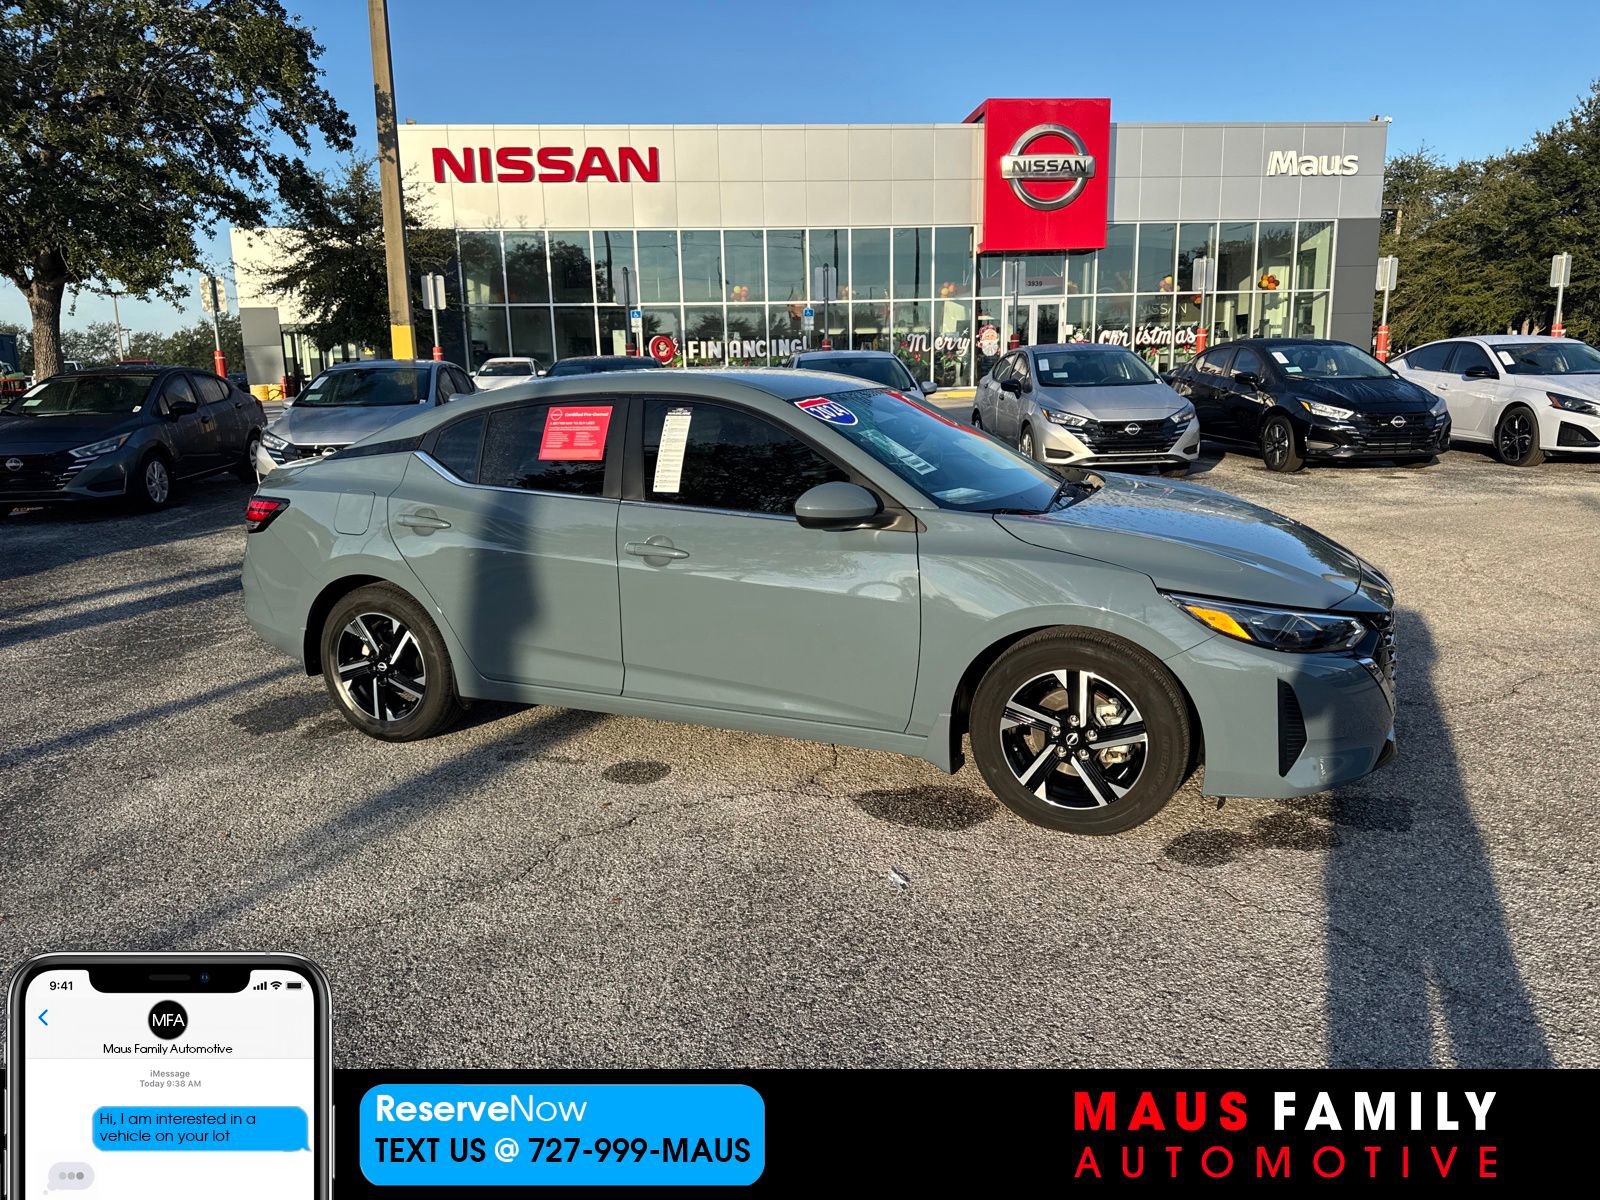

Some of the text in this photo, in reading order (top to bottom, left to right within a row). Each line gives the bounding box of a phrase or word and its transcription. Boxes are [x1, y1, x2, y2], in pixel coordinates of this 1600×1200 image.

[432, 146, 660, 183] NISSAN
[1011, 159, 1087, 174] NISSAN
[1267, 150, 1359, 177] Maus
[907, 333, 971, 357] Merry
[809, 403, 850, 420] 2024
